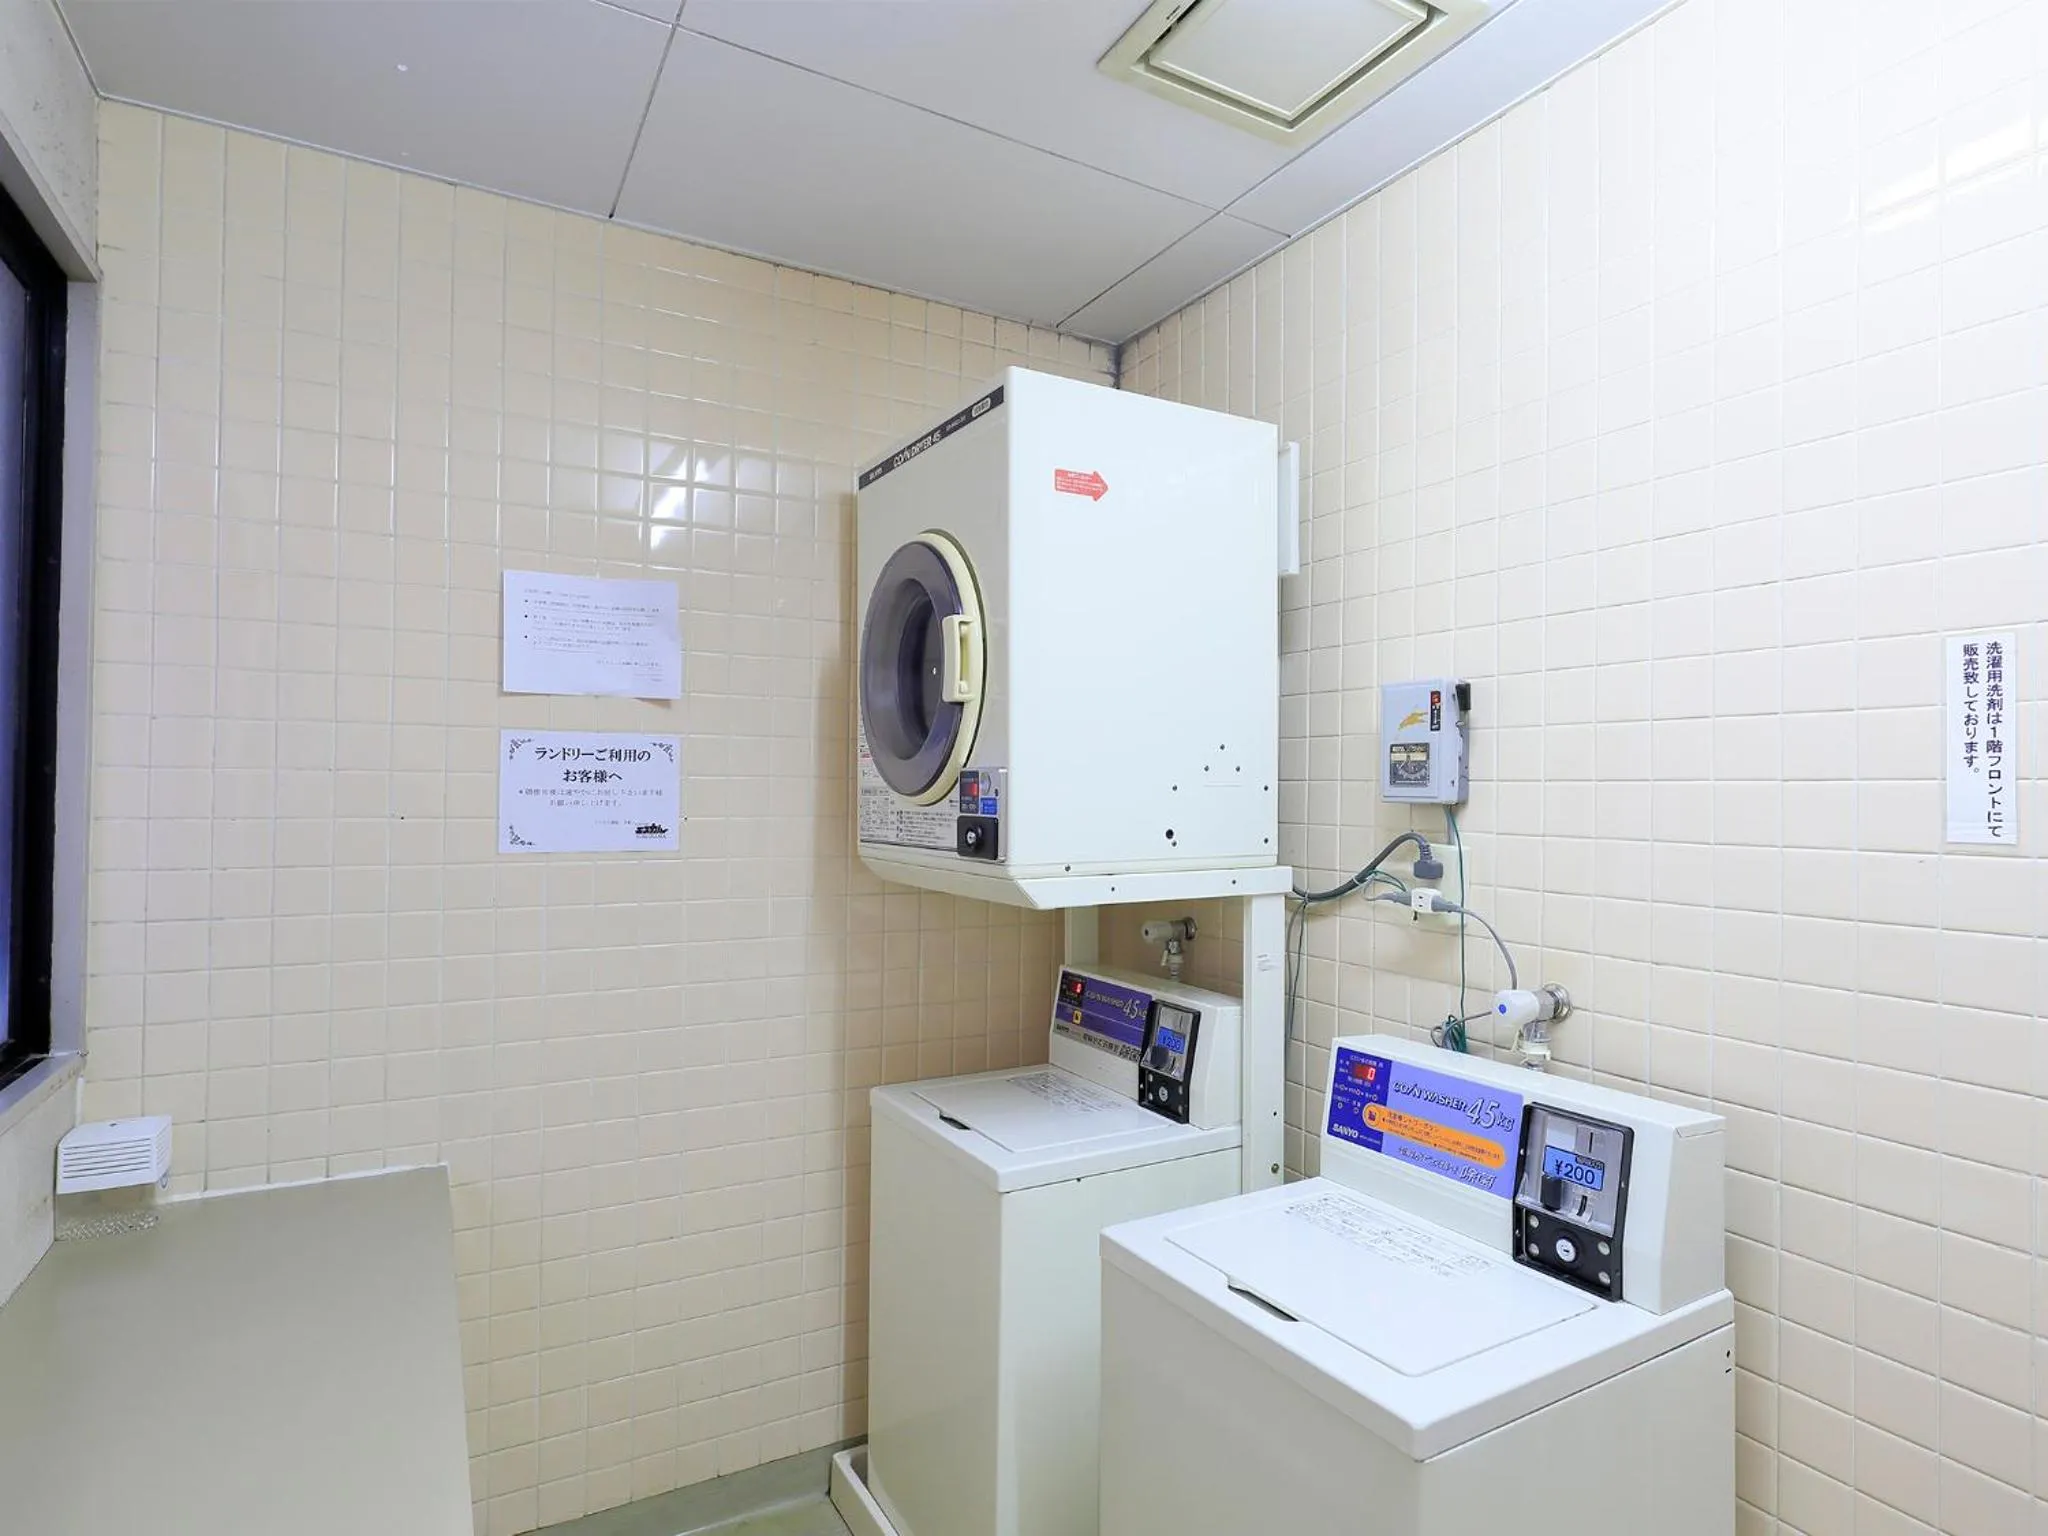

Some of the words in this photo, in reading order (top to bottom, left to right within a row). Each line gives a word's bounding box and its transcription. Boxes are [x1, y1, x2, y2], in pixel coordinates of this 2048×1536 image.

[1963, 643, 1980, 774] 販売致しております。
[1986, 640, 2003, 838] 洗濯用洗剤は1階フロントにて
[534, 747, 651, 763] ランドリーご利用の
[563, 769, 623, 784] お客様へ
[1393, 1082, 1422, 1099] COIN
[1422, 1089, 1468, 1112] WASHER
[1332, 1123, 1358, 1138] SANYO
[1555, 1159, 1595, 1185] ¥200
